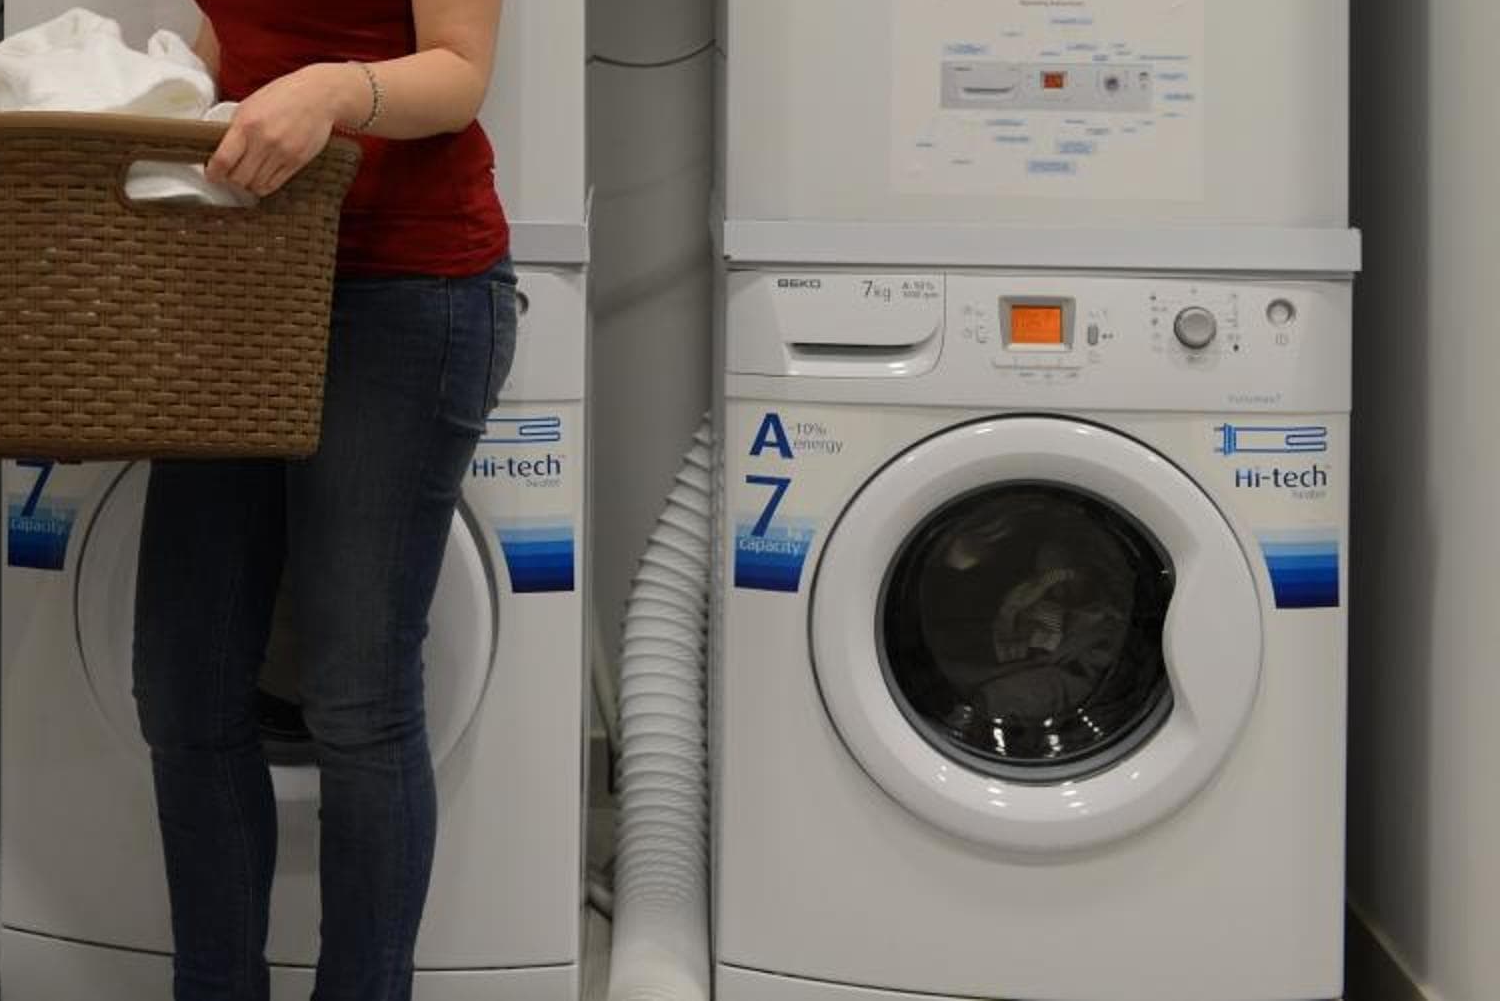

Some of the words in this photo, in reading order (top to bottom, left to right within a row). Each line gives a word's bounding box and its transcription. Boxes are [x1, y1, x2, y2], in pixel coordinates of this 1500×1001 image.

[777, 278, 822, 289] BEKO
[862, 280, 891, 303] 7kg
[749, 412, 794, 459] A
[793, 439, 844, 455] energy
[472, 453, 562, 478] Hi-tech
[1235, 464, 1327, 488] Hi-tech
[16, 458, 55, 517] 7
[745, 474, 792, 538] 7
[11, 518, 66, 536] capacity
[738, 537, 802, 556] capacity
